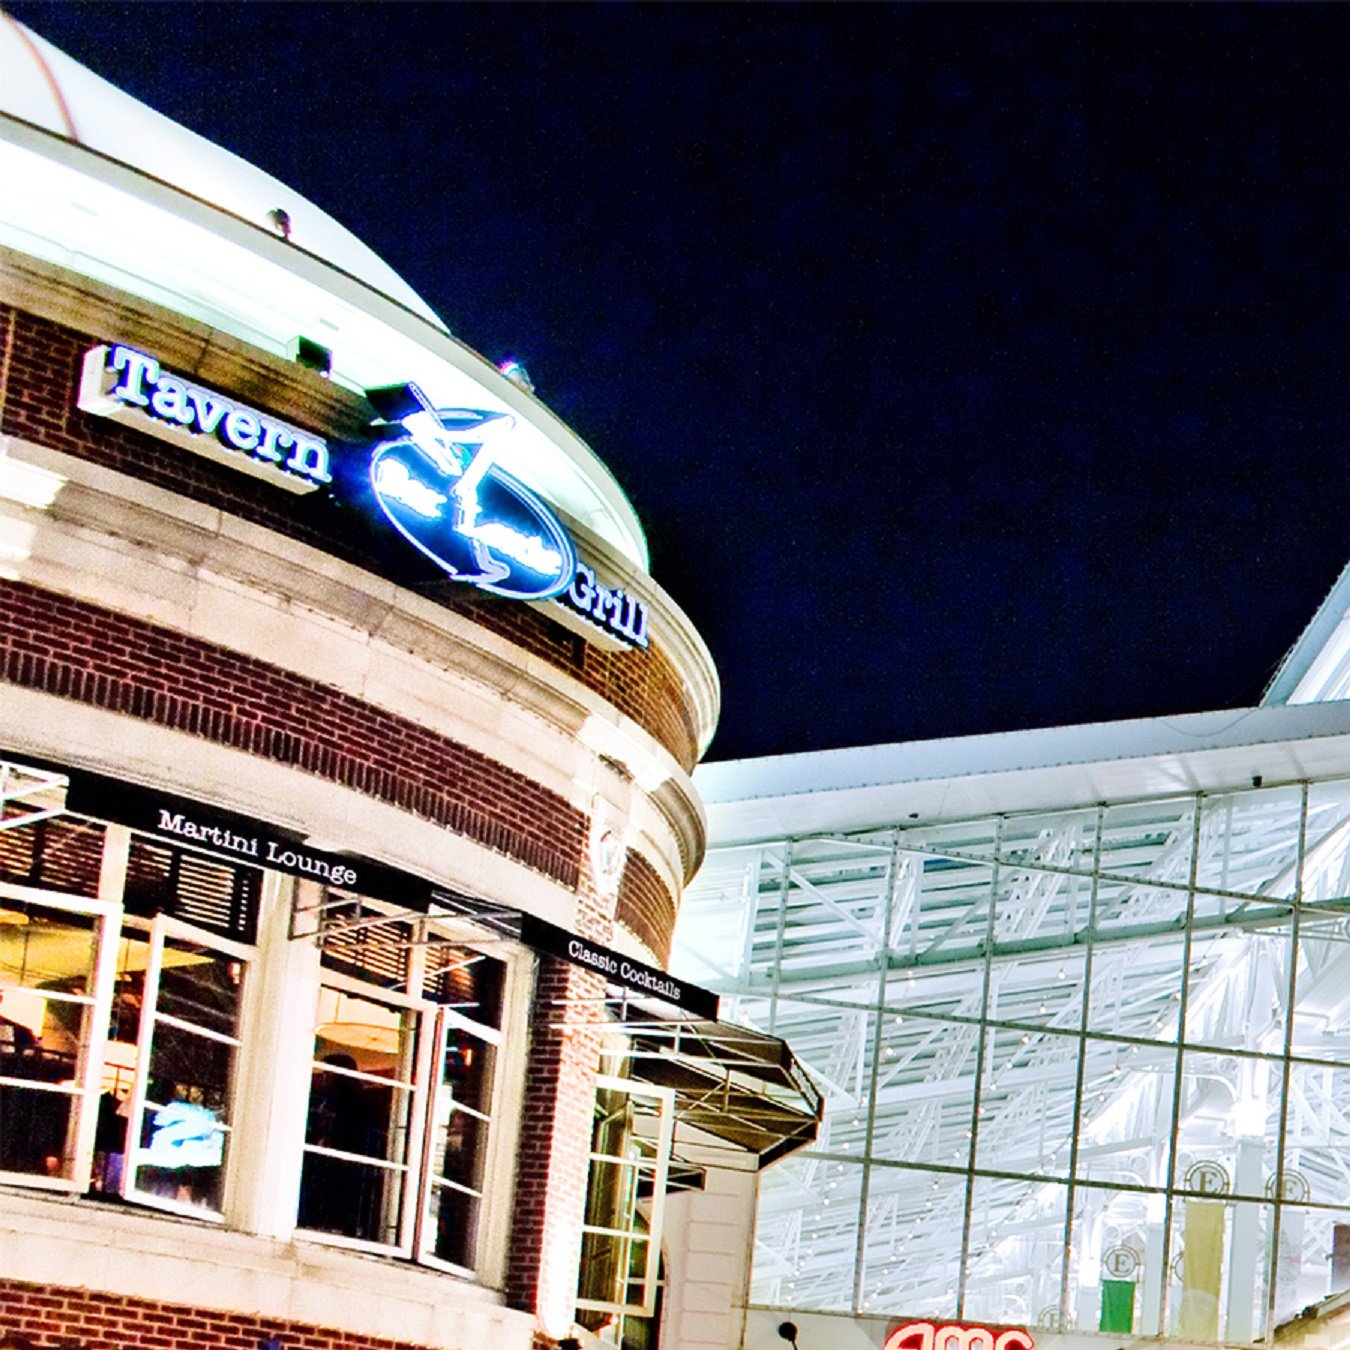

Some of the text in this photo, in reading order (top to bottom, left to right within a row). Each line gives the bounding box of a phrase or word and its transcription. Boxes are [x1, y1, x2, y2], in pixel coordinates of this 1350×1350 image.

[110, 342, 333, 483] Tavern
[566, 561, 650, 648] Grill
[157, 809, 358, 885] Martini Lounge
[568, 940, 681, 1000] Classic Cocktails
